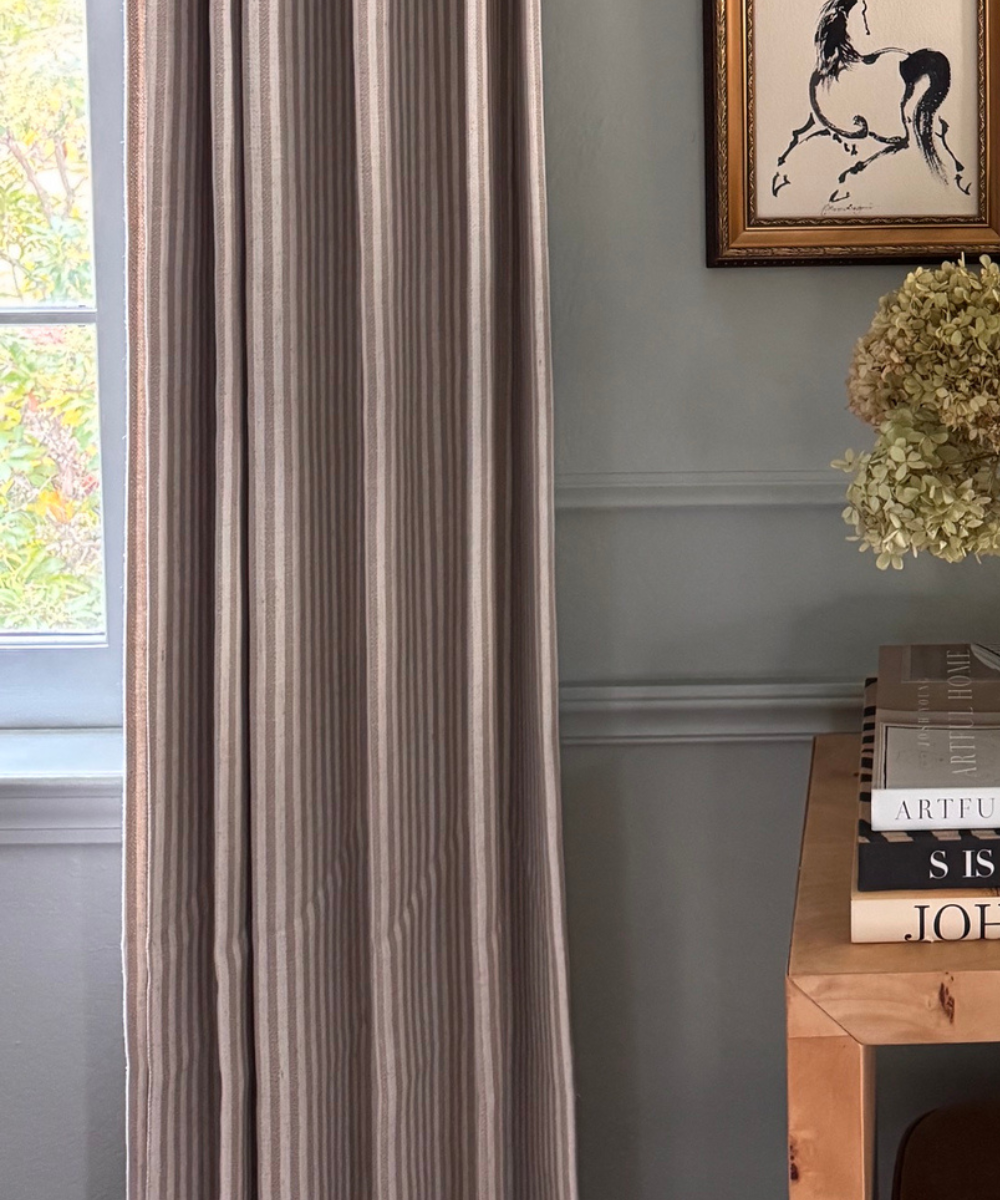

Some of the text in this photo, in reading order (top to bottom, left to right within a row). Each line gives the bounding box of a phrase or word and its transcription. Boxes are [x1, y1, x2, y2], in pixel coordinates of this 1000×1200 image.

[946, 649, 977, 777] ARTFUL HOME
[929, 850, 949, 879] S
[962, 849, 995, 878] IS
